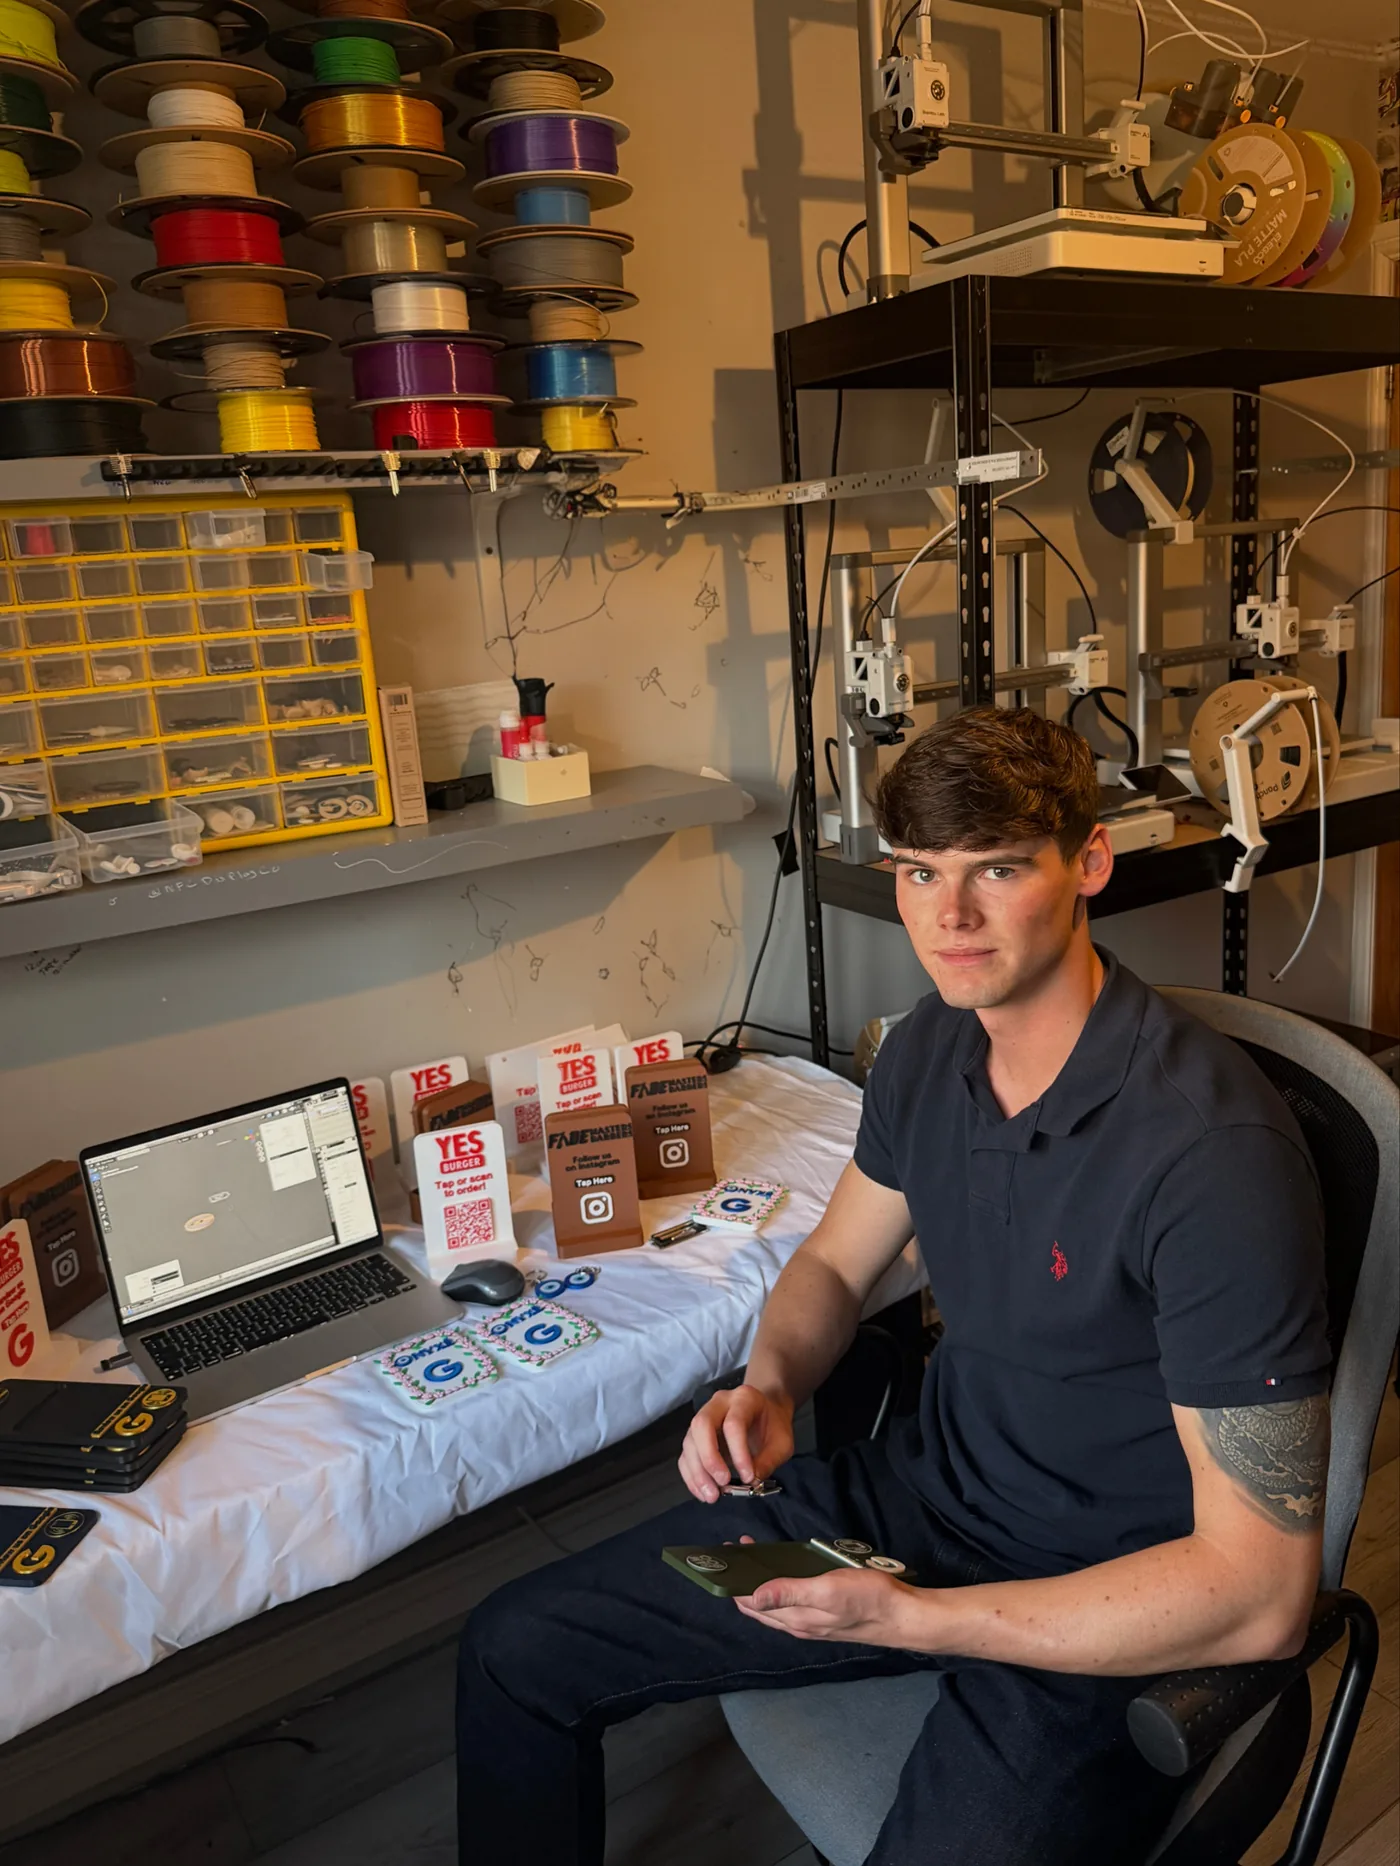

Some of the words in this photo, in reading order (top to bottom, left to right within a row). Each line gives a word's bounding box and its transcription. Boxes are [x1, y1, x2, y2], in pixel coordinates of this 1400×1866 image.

[1255, 208, 1288, 247] MATTE
[1234, 245, 1255, 267] PLA
[1256, 783, 1279, 800] Panch
[632, 1038, 670, 1066] YES
[410, 1063, 453, 1092] YES
[655, 1126, 670, 1135] Tap
[670, 1124, 690, 1133] Here
[435, 1130, 485, 1160] YES
[442, 1157, 482, 1173] BURGER
[572, 1154, 600, 1163] Follow
[434, 1180, 454, 1190] Tap
[456, 1178, 467, 1186] or
[469, 1173, 493, 1181] scan
[444, 1189, 454, 1198] to
[456, 1182, 487, 1196] order!
[575, 1179, 592, 1188] Tap
[592, 1176, 613, 1185] Here
[720, 1198, 752, 1213] G
[8, 1323, 35, 1367] G
[524, 1323, 564, 1345] G
[423, 1358, 464, 1383] G
[114, 1412, 154, 1436] G
[12, 1545, 56, 1574] G
